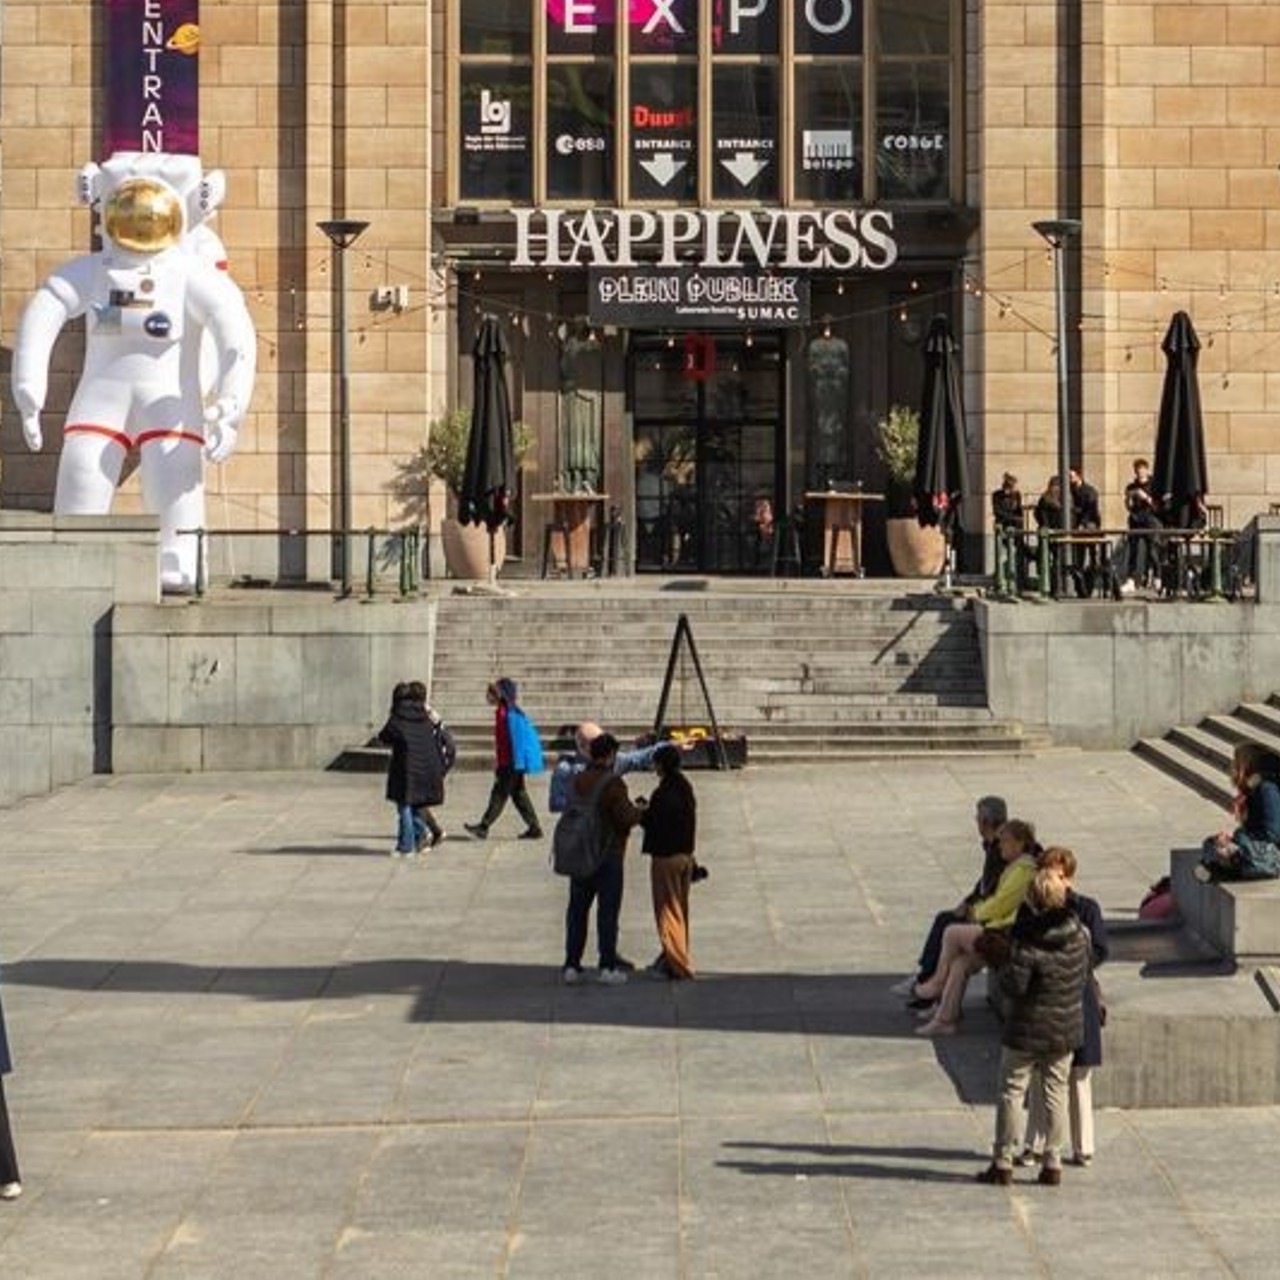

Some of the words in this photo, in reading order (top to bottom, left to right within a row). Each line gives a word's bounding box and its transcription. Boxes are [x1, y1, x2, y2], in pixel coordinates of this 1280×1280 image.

[634, 139, 692, 150] ENTRANCE
[717, 139, 774, 150] ENTRANCE
[509, 208, 898, 268] HAPPINESS
[737, 306, 799, 320] SUMAC
